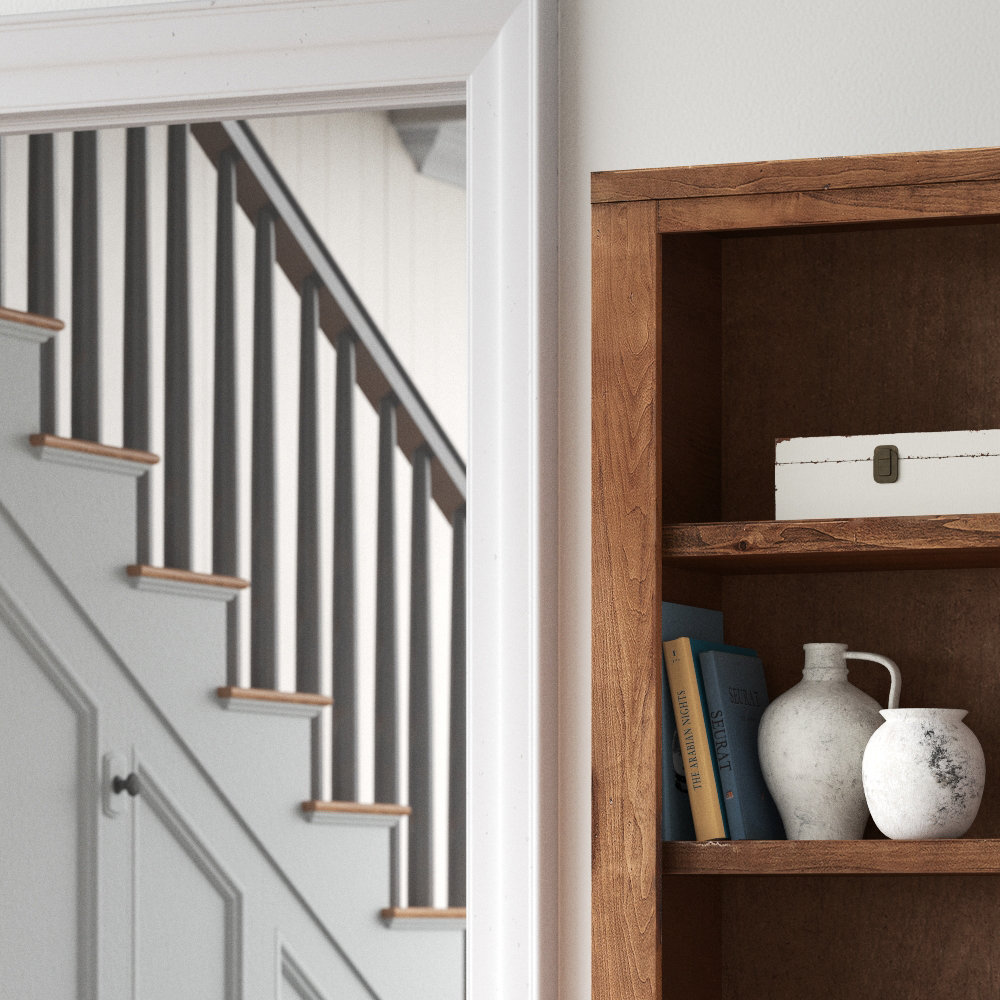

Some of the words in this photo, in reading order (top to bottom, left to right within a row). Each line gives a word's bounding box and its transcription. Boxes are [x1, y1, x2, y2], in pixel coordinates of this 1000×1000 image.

[677, 689, 690, 726] NIGHTS
[684, 728, 698, 769] ARABIAN
[711, 710, 732, 772] SEURAT
[691, 771, 702, 791] THE
